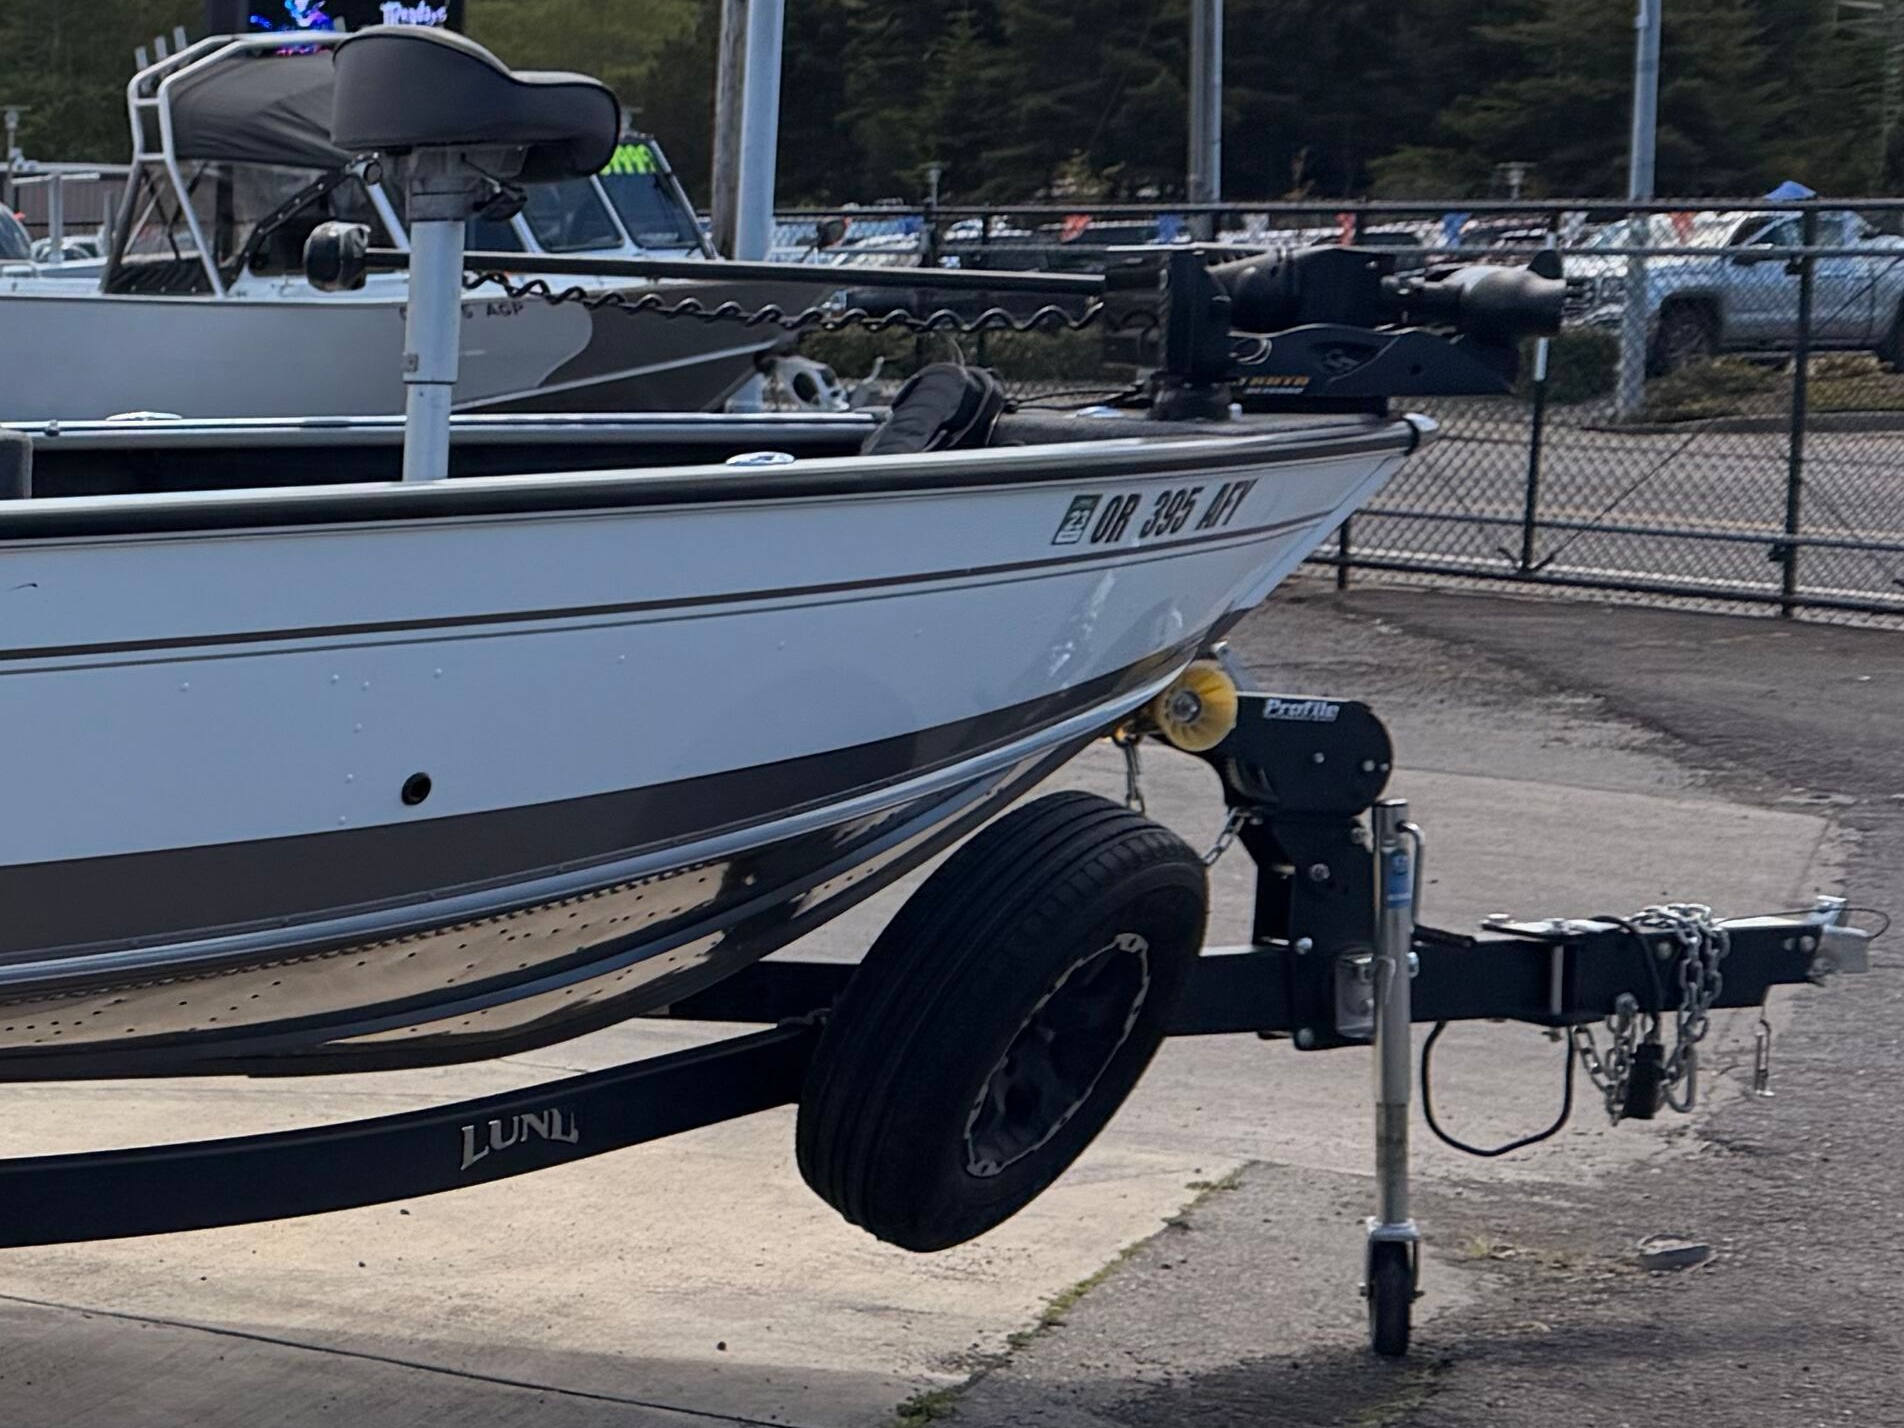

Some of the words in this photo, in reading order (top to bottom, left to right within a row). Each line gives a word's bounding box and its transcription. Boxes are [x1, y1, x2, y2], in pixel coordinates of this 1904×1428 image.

[1090, 493, 1142, 545] OR
[1139, 486, 1206, 540] 395
[1194, 478, 1260, 531] AFY
[1264, 698, 1340, 720] Profile
